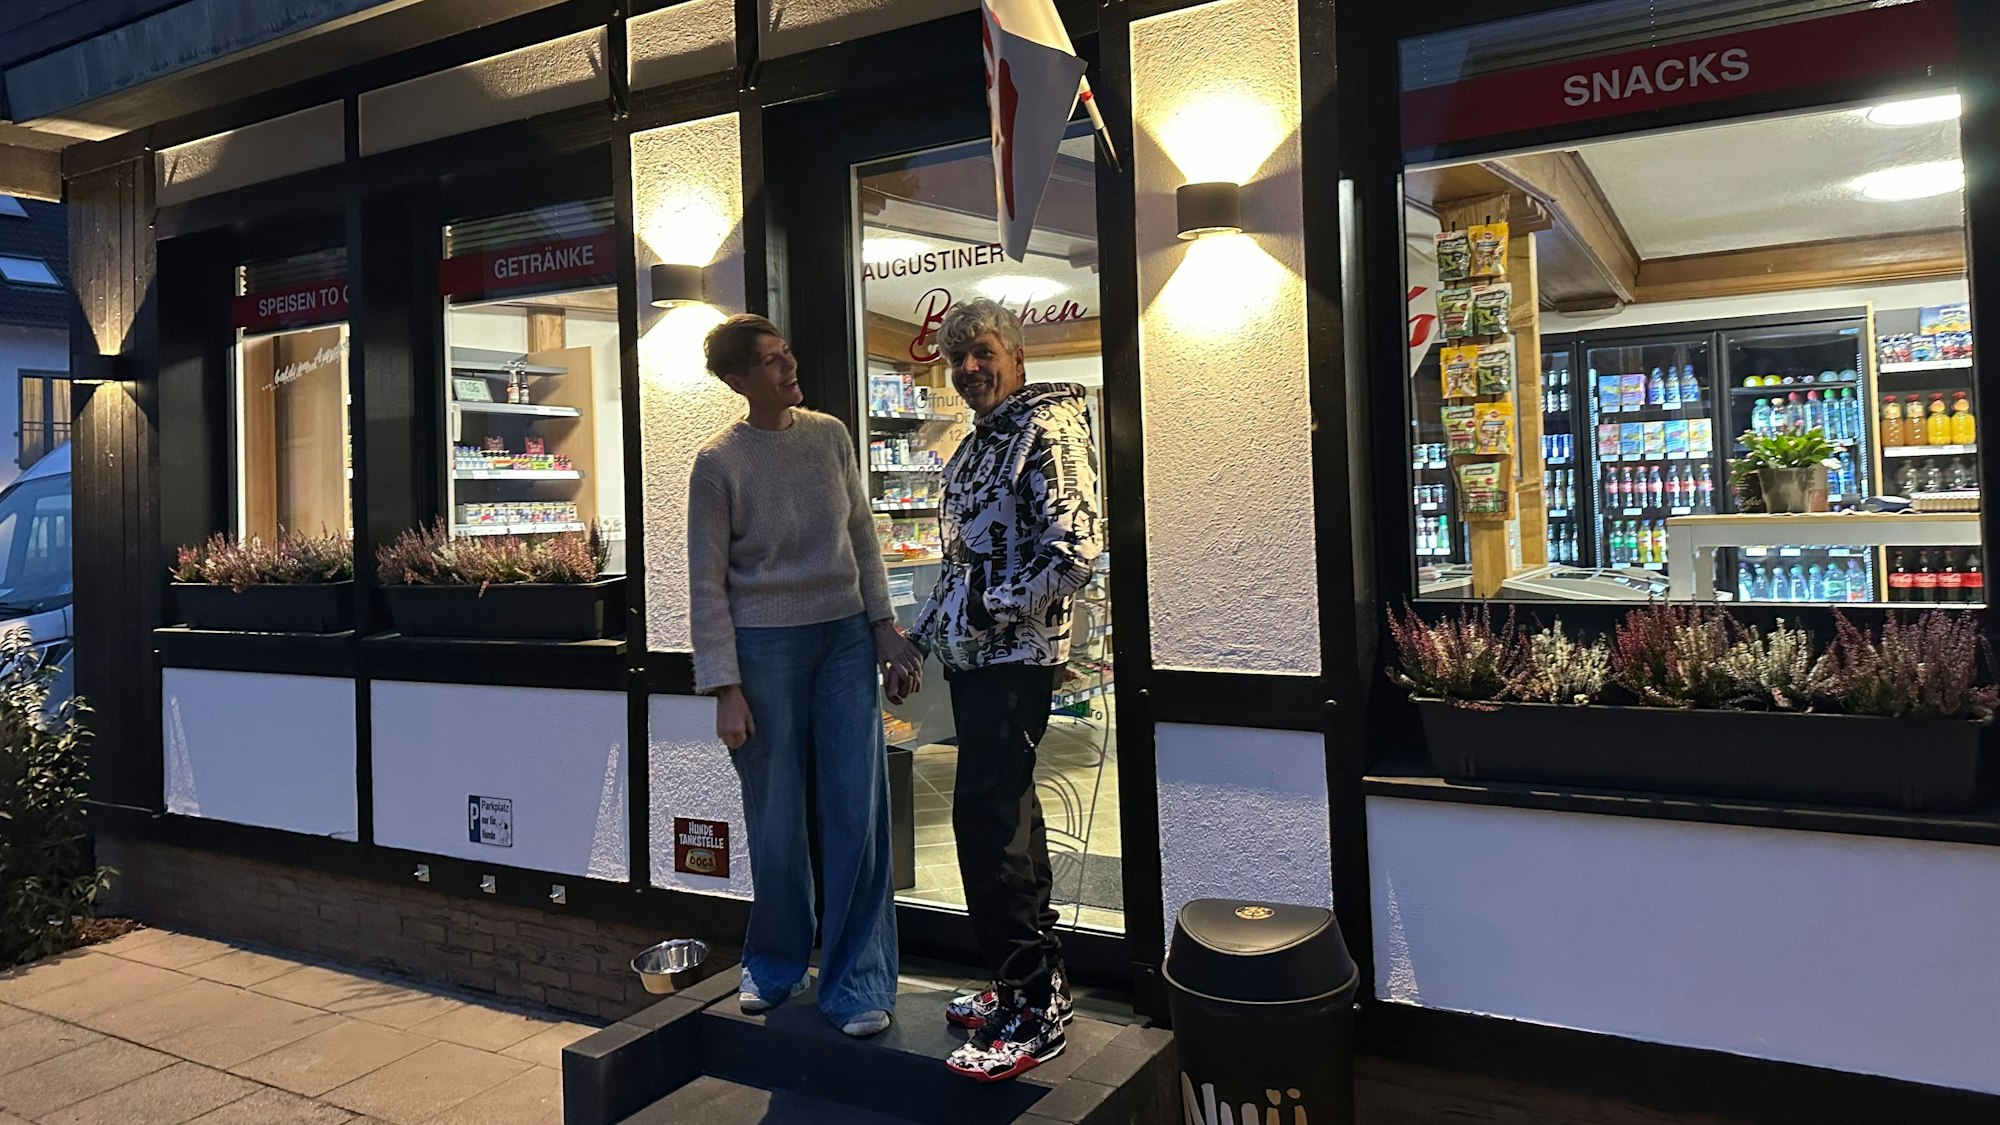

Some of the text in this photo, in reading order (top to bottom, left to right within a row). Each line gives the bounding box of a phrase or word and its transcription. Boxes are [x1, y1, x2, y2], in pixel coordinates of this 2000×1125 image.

[1563, 48, 1750, 107] SNACKS
[494, 245, 595, 279] GETRÄNKE
[861, 243, 1005, 281] AUGUSTINER
[258, 290, 316, 317] SPEISEN
[320, 287, 339, 307] TO
[909, 288, 1088, 363] Bhen
[915, 390, 970, 409] Öffnun
[470, 800, 510, 831] P Parkplatz
[688, 821, 714, 836] HUNDE
[679, 832, 725, 849] TANKSTELLE
